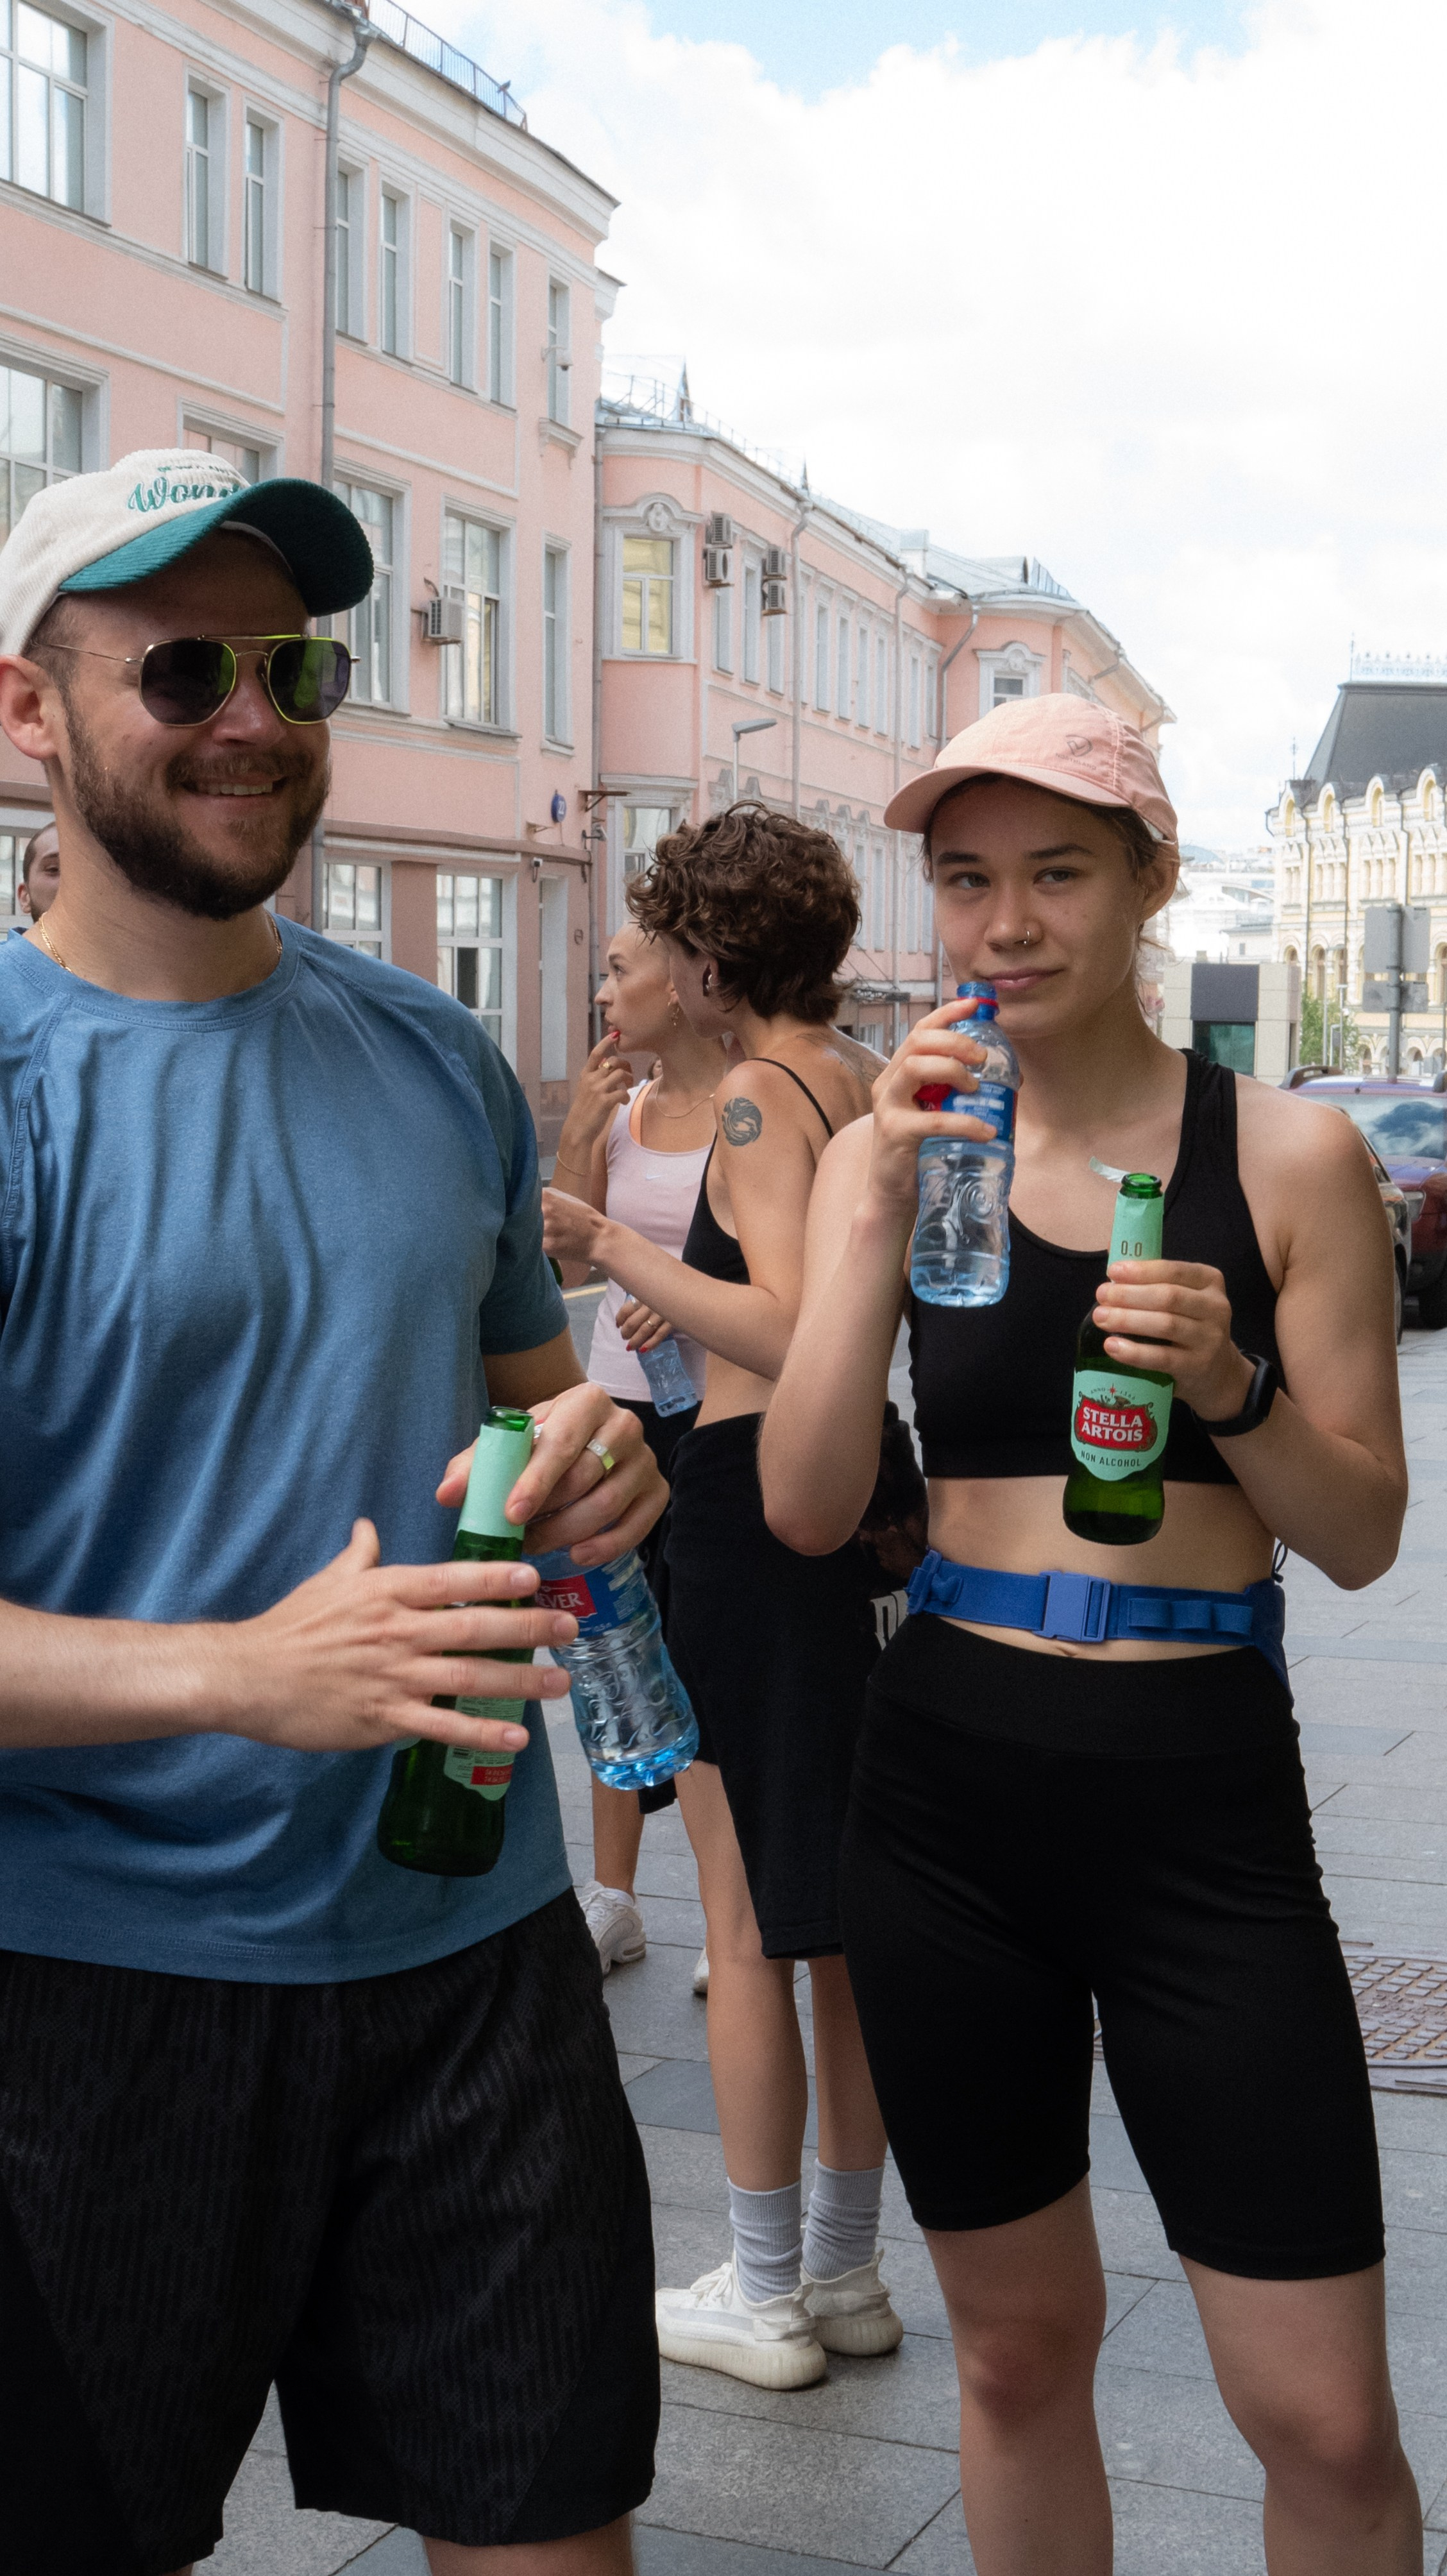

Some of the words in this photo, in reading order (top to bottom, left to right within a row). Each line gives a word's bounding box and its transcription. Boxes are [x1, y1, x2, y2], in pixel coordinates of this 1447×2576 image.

[1121, 1240, 1143, 1257] 0.0
[1083, 1406, 1143, 1428] STELLA
[1081, 1421, 1143, 1442] ARTOIS
[1081, 1450, 1096, 1462] NON
[1099, 1457, 1141, 1467] ALCOHOL
